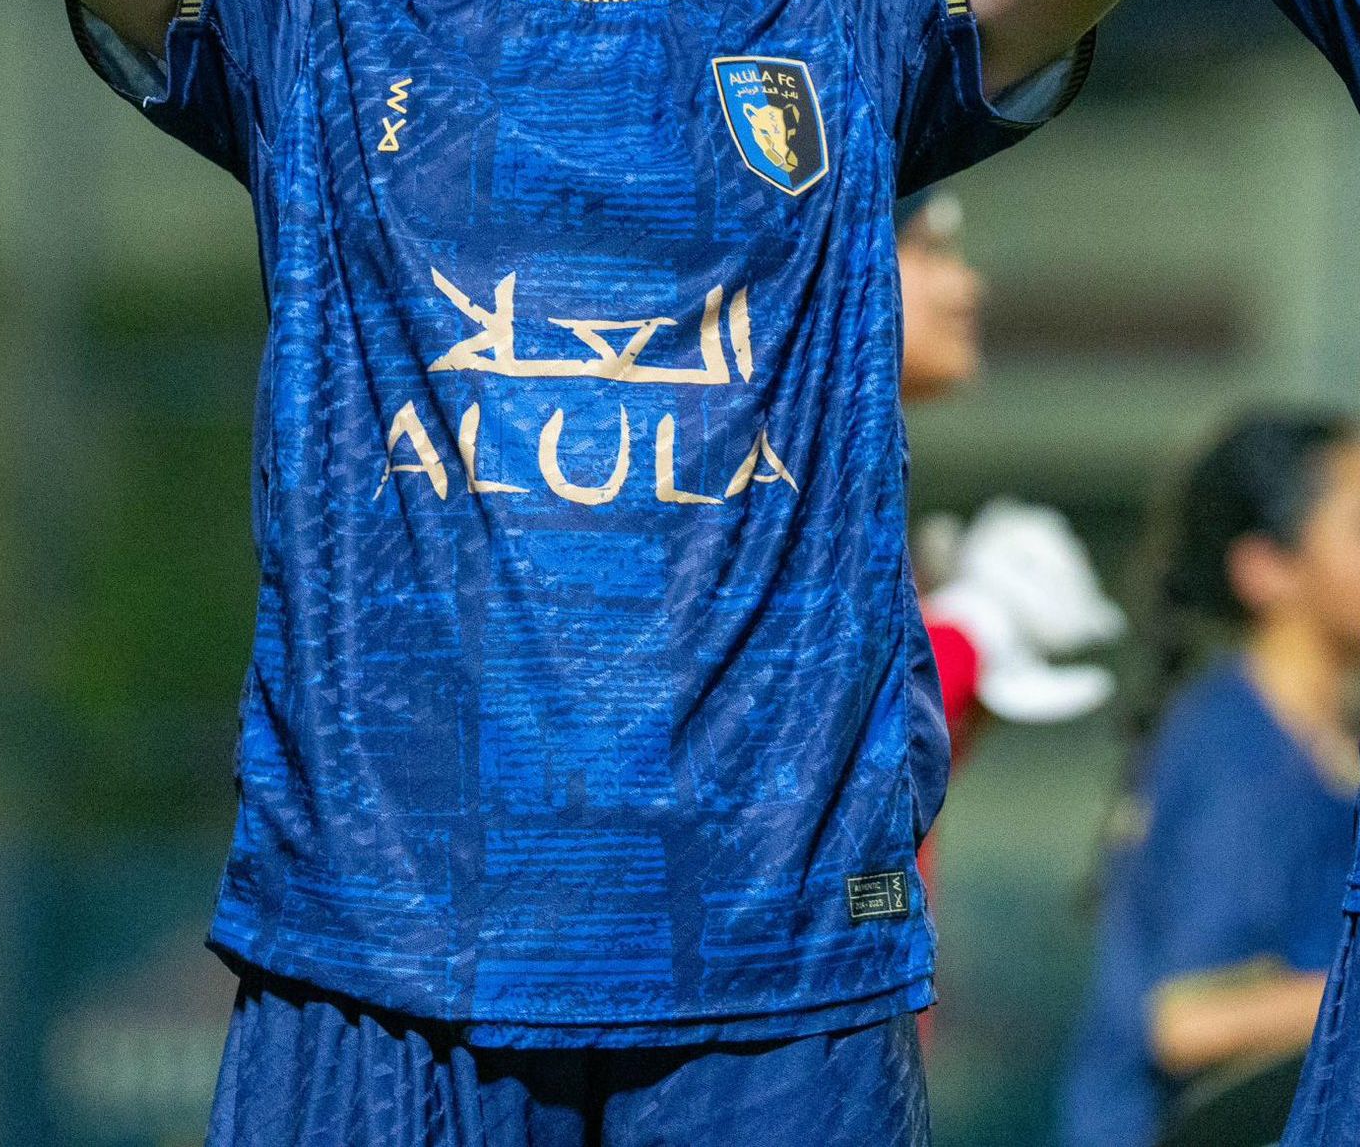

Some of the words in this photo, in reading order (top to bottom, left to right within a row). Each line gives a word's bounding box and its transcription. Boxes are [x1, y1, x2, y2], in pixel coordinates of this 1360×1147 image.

[728, 69, 774, 86] ALULA
[777, 72, 796, 89] FC
[426, 266, 754, 385] العلا
[372, 400, 800, 506] ALULA
